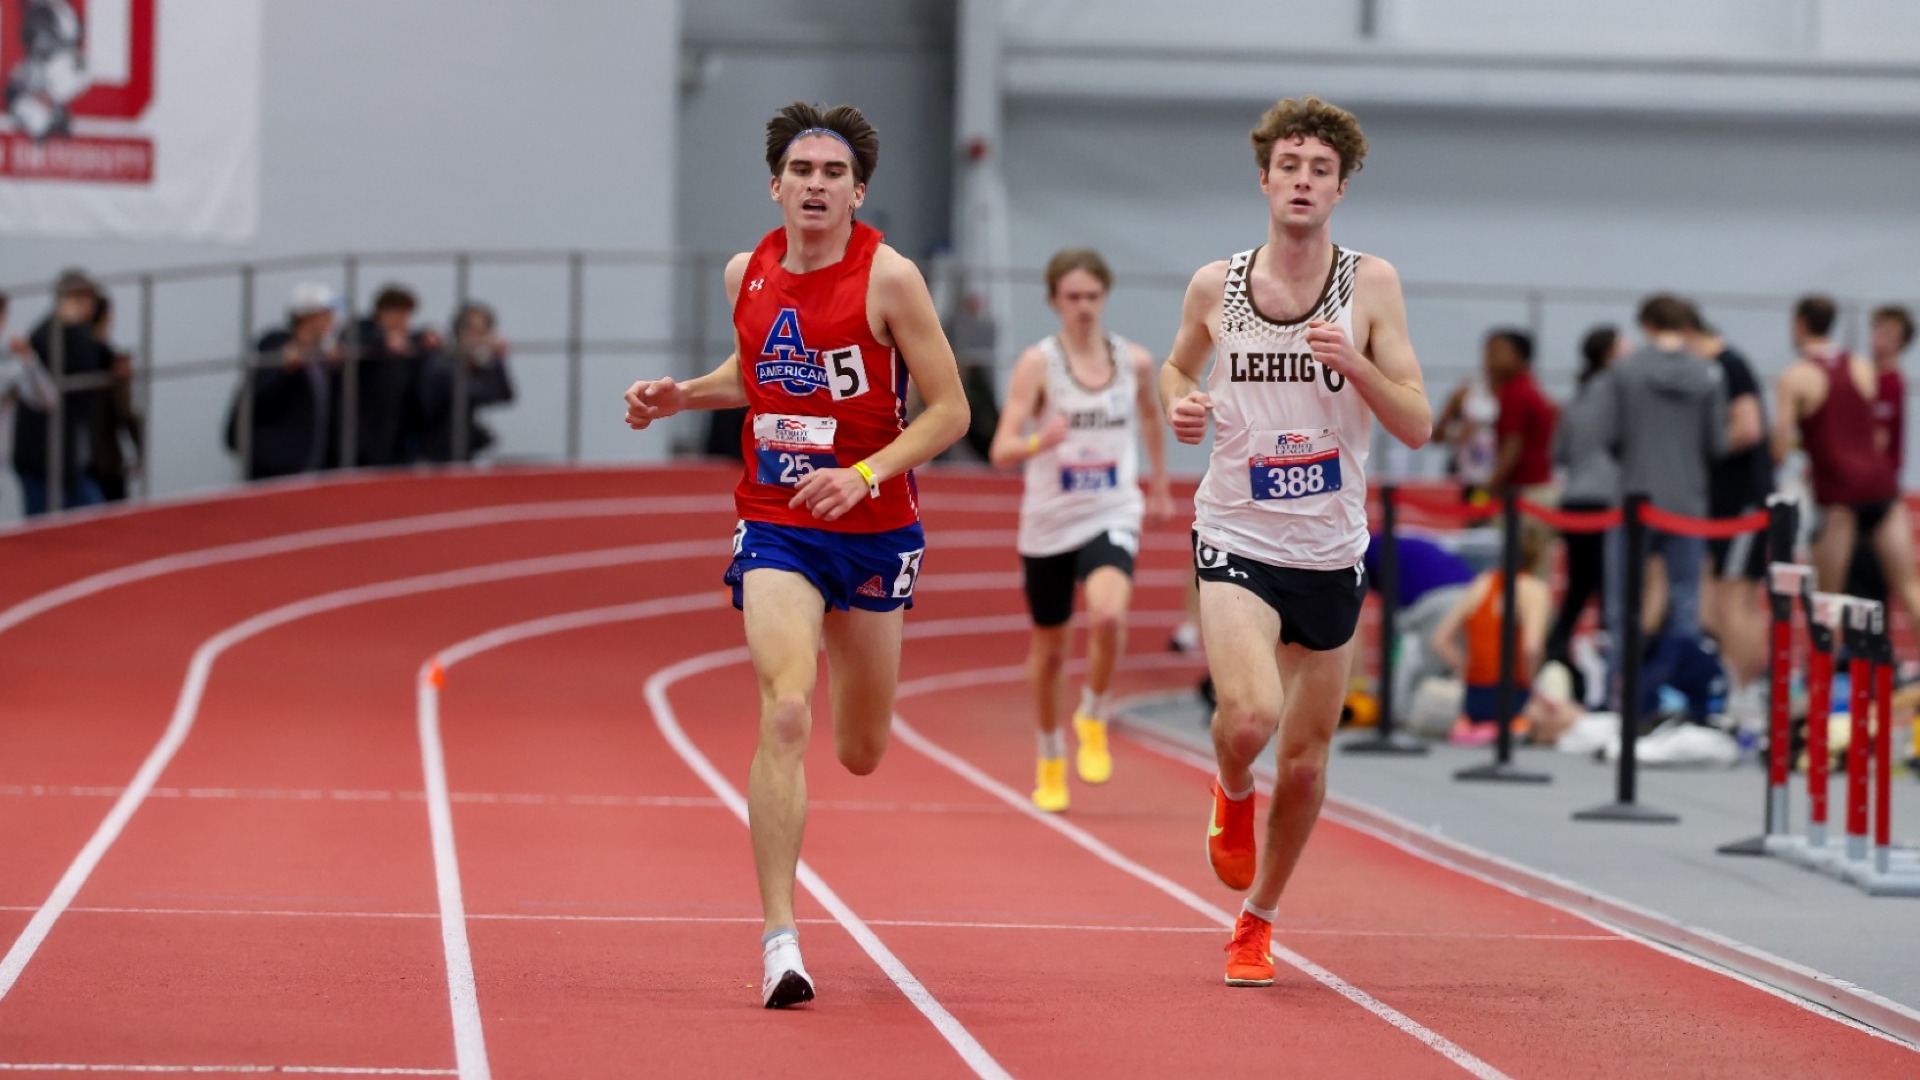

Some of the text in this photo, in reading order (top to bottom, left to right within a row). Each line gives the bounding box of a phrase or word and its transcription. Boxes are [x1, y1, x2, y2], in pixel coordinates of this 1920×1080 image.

[760, 365, 828, 382] AMERICAN
[832, 350, 860, 397] 5
[1230, 352, 1316, 383] LEHIG
[779, 453, 815, 483] 25
[1267, 464, 1325, 498] 388
[899, 552, 920, 596] 5
